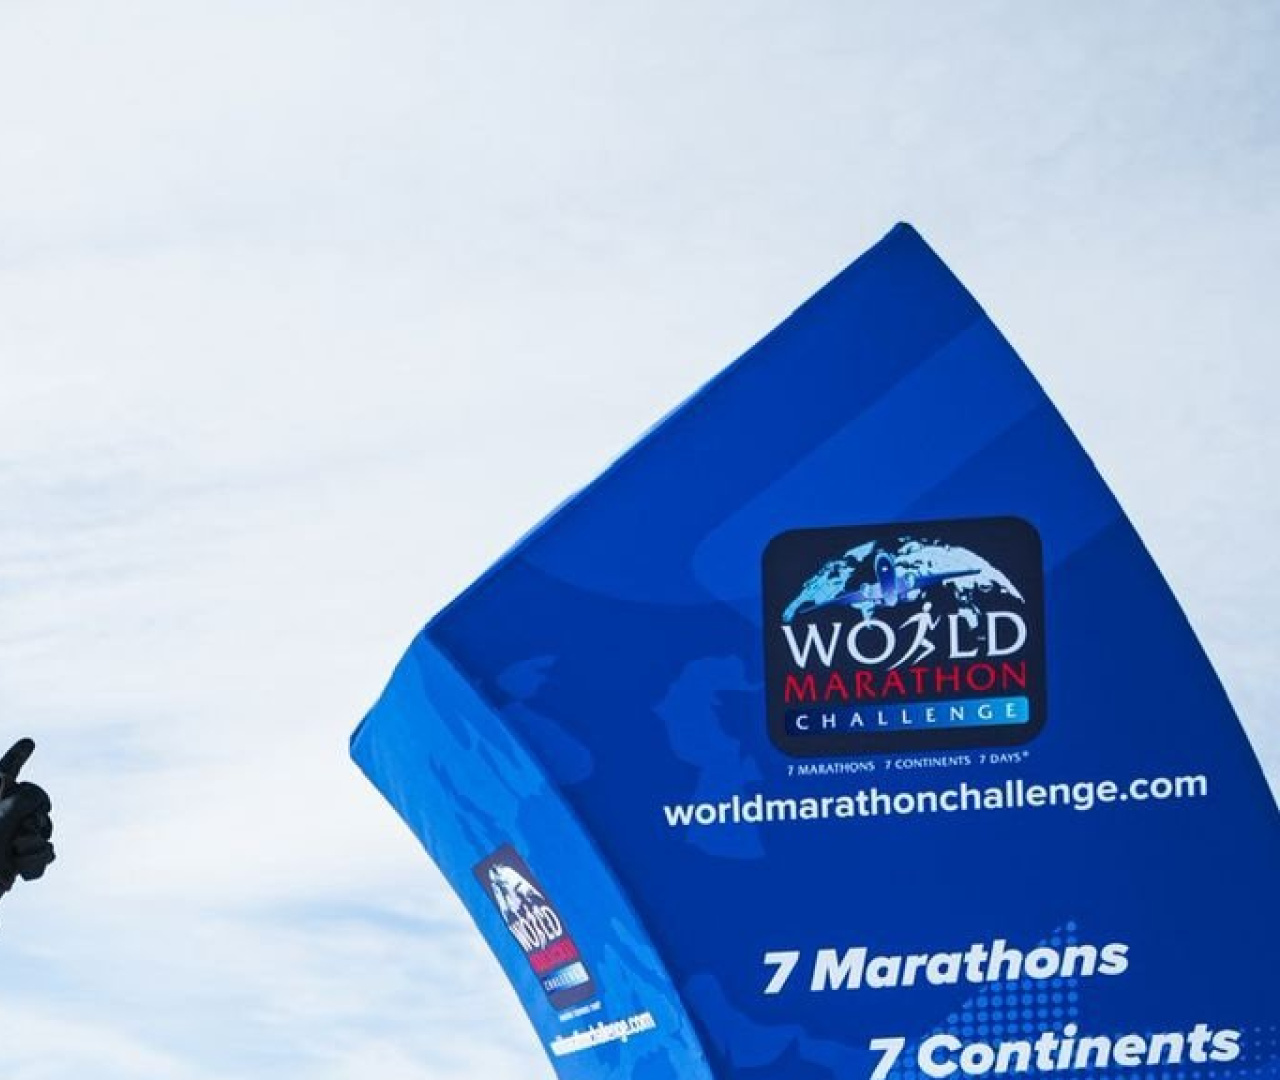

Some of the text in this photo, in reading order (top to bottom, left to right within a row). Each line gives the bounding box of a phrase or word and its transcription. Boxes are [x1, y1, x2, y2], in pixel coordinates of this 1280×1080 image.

[784, 661, 1027, 703] MARATHON
[795, 702, 1017, 730] CHALLENGE
[787, 765, 794, 776] 7
[798, 761, 875, 775] MARATHONS
[885, 759, 892, 770] 7
[895, 756, 971, 769] CONTINENTS
[979, 755, 986, 765] 7
[664, 771, 1208, 826] worldmarathonchallenge.com
[763, 939, 1130, 995] 7 Marathons
[869, 1023, 1241, 1080] 7 Continents
